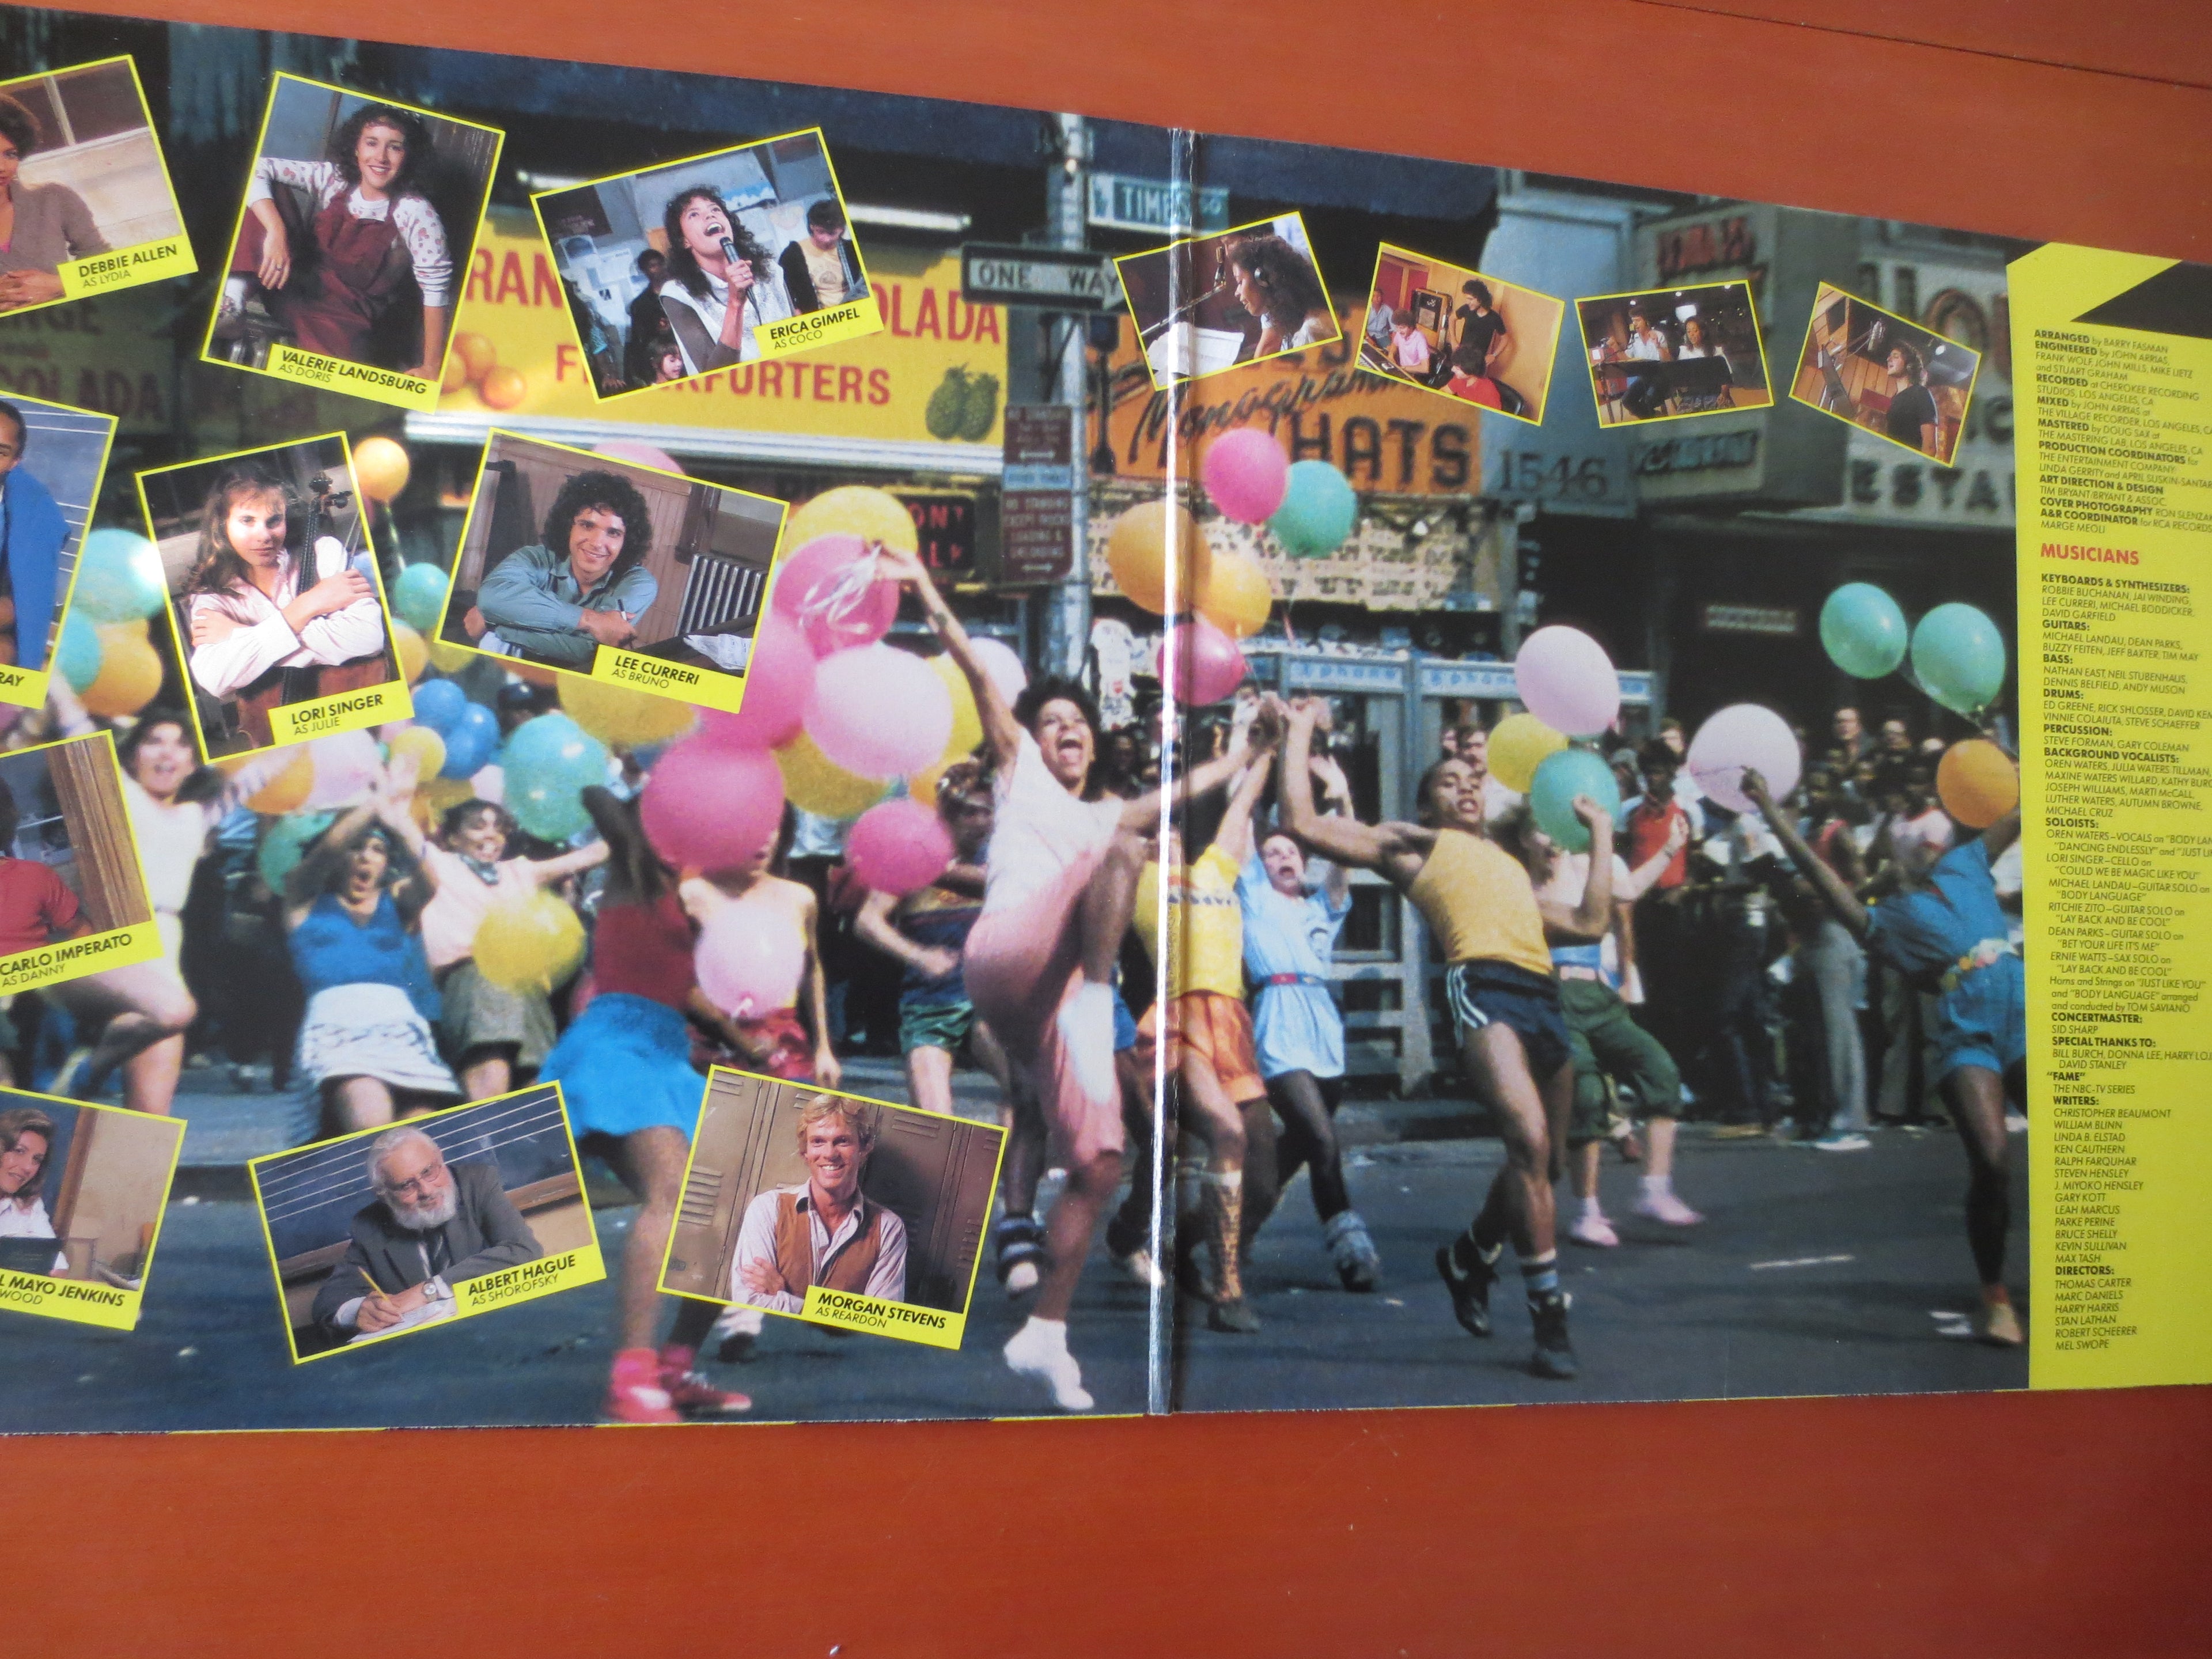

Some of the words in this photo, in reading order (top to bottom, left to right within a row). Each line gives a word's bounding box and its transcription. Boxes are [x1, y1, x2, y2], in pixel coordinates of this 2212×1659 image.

[78, 255, 129, 278] DEBBIE
[132, 244, 177, 266] ALLEN
[82, 278, 98, 288] AS
[100, 270, 131, 285] LYDIA
[979, 262, 1032, 288] ONE
[1068, 266, 1119, 296] WAY
[770, 323, 808, 340] ERICA
[811, 308, 860, 330] GIMPEL
[774, 339, 787, 350] AS
[789, 329, 823, 346] COCO
[2034, 329, 2089, 343] ARRANGED
[2092, 337, 2101, 346] by
[2104, 338, 2131, 348] BARRY
[2132, 342, 2168, 353] FASMAN
[278, 365, 293, 373] AS
[296, 368, 332, 383] DORIS
[282, 350, 337, 373] VALERIE
[338, 363, 427, 395] LANDSBURG
[2036, 373, 2088, 387] RECORDED
[2100, 382, 2146, 393] CHEROKEE
[2149, 387, 2199, 400] RECORDING
[2038, 418, 2089, 431] MASTERED
[2092, 425, 2101, 434] by
[2104, 426, 2132, 437] DOUG
[2134, 429, 2150, 438] SAX
[2039, 441, 2106, 455] PRODUCTION
[2108, 448, 2186, 464] COORDINATORS
[2039, 475, 2058, 483] ART
[2061, 478, 2114, 490] DIRECTION
[2126, 483, 2164, 494] DESIGN
[2040, 497, 2074, 508] COVER
[2075, 501, 2153, 515] PHOTOGRAPHY
[2041, 521, 2075, 531] MARGE
[2040, 543, 2139, 565] MUSICIANS
[2041, 574, 2103, 586] KEYBOARDS
[2115, 579, 2190, 593] SYNTHESIZERS:
[2042, 585, 2075, 596] ROBBIE
[2133, 593, 2145, 601] JAI
[2043, 608, 2070, 618] DAVID
[2073, 611, 2116, 621] GARFIELD
[2043, 620, 2090, 631] GUITARS:
[2043, 632, 2084, 642] MICHAEL
[2086, 634, 2126, 645] LANDAU,
[2128, 638, 2152, 646] DEAN
[2043, 654, 2073, 664] BASS:
[615, 655, 637, 670] LEE
[641, 661, 700, 685] CURRERI
[612, 668, 626, 678] AS
[628, 671, 669, 688] BRUNO
[2043, 677, 2078, 687] DENNIS
[2081, 680, 2120, 691] BELFIELD,
[2123, 683, 2148, 692] ANDY
[2150, 685, 2185, 694] MUSON
[2043, 689, 2084, 699] DRUMS:
[291, 707, 325, 725] LORI
[328, 694, 384, 717] SINGER
[294, 724, 308, 735] AS
[311, 717, 340, 732] JULIE
[2044, 724, 2112, 736] PERCUSSION:
[2044, 748, 2119, 759] BACKGROUND
[2122, 752, 2179, 763] VOCALISTS:
[2045, 806, 2087, 816] MICHAEL
[2089, 808, 2113, 817] CRUZ
[2045, 818, 2099, 828] SOLOISTS:
[0, 953, 52, 975] CARLO
[56, 933, 132, 962] IMPERATO
[2, 975, 17, 988] AS
[21, 964, 65, 983] DANNY
[2051, 1013, 2142, 1023] CONCERTMASTER:
[2051, 1025, 2066, 1033] SID
[2069, 1025, 2098, 1035] SHARP
[2052, 1037, 2093, 1046] SPECIAL
[2095, 1038, 2137, 1047] THANKS
[2139, 1039, 2156, 1047] TO:
[2059, 1060, 2087, 1069] DAVID
[2089, 1060, 2126, 1070] STANLEY
[2054, 1085, 2070, 1093] THE
[2073, 1085, 2105, 1093] NBC-TV
[2107, 1085, 2135, 1094] SERIES
[2054, 1096, 2099, 1105] WRITERS:
[2054, 1108, 2115, 1118] CHRISTOPHER
[2118, 1109, 2171, 1118] BEAUMONT
[2054, 1120, 2092, 1129] WILLIAM
[2096, 1121, 2122, 1129] BLINN
[2054, 1133, 2084, 1142] LINDA
[2085, 1133, 2092, 1141] B.
[2094, 1132, 2126, 1142] ELSTAD
[2055, 1145, 2073, 1153] KEN
[2075, 1145, 2125, 1153] CAUTHERN
[2055, 1157, 2083, 1165] RALPH
[2086, 1157, 2137, 1166] FARQUHAR
[2055, 1169, 2087, 1177] STEVEN
[2090, 1169, 2129, 1177] HENSLEY
[2054, 1181, 2060, 1190] J.
[2063, 1181, 2101, 1190] MIYOKO
[2104, 1181, 2143, 1190] HENSLEY
[2055, 1193, 2081, 1202] GARY
[2082, 1193, 2106, 1202] KOTT
[2055, 1205, 2078, 1214] LEAH
[2081, 1205, 2120, 1214] MARCUS
[2055, 1218, 2082, 1226] PARKE
[2085, 1218, 2115, 1226] PERINE
[2055, 1230, 2085, 1238] BRUCE
[2086, 1230, 2118, 1238] SHELLY
[2055, 1242, 2081, 1251] KEVIN
[2084, 1242, 2127, 1251] SULLIVAN
[2055, 1254, 2076, 1263] MAX
[2080, 1254, 2101, 1262] TASH
[468, 1270, 520, 1296] ALBERT
[523, 1255, 576, 1280] HAGUE
[2055, 1266, 2114, 1275] DIRECTORS:
[2055, 1279, 2094, 1289] THOMAS
[2097, 1278, 2131, 1287] CARTER
[9, 1276, 56, 1294] MAYO
[58, 1285, 125, 1306] JENKINS
[472, 1296, 486, 1306] AS
[489, 1274, 558, 1302] SHOROFSKY
[2055, 1291, 2083, 1301] MARC
[2085, 1290, 2124, 1300] DANIELS
[818, 1293, 886, 1316] MORGAN
[888, 1307, 946, 1329] STEVENS
[2055, 1305, 2085, 1313] HARRY
[2088, 1303, 2119, 1312] HARRIS
[815, 1306, 830, 1316] AS
[832, 1310, 887, 1328] REARDON
[2055, 1316, 2078, 1325] STAN
[2081, 1315, 2116, 1324] LATHAN
[2055, 1328, 2090, 1338] ROBERT
[2093, 1326, 2137, 1336] SCHEERER
[2055, 1341, 2074, 1350] MEL
[2077, 1339, 2109, 1349] SWOPE
